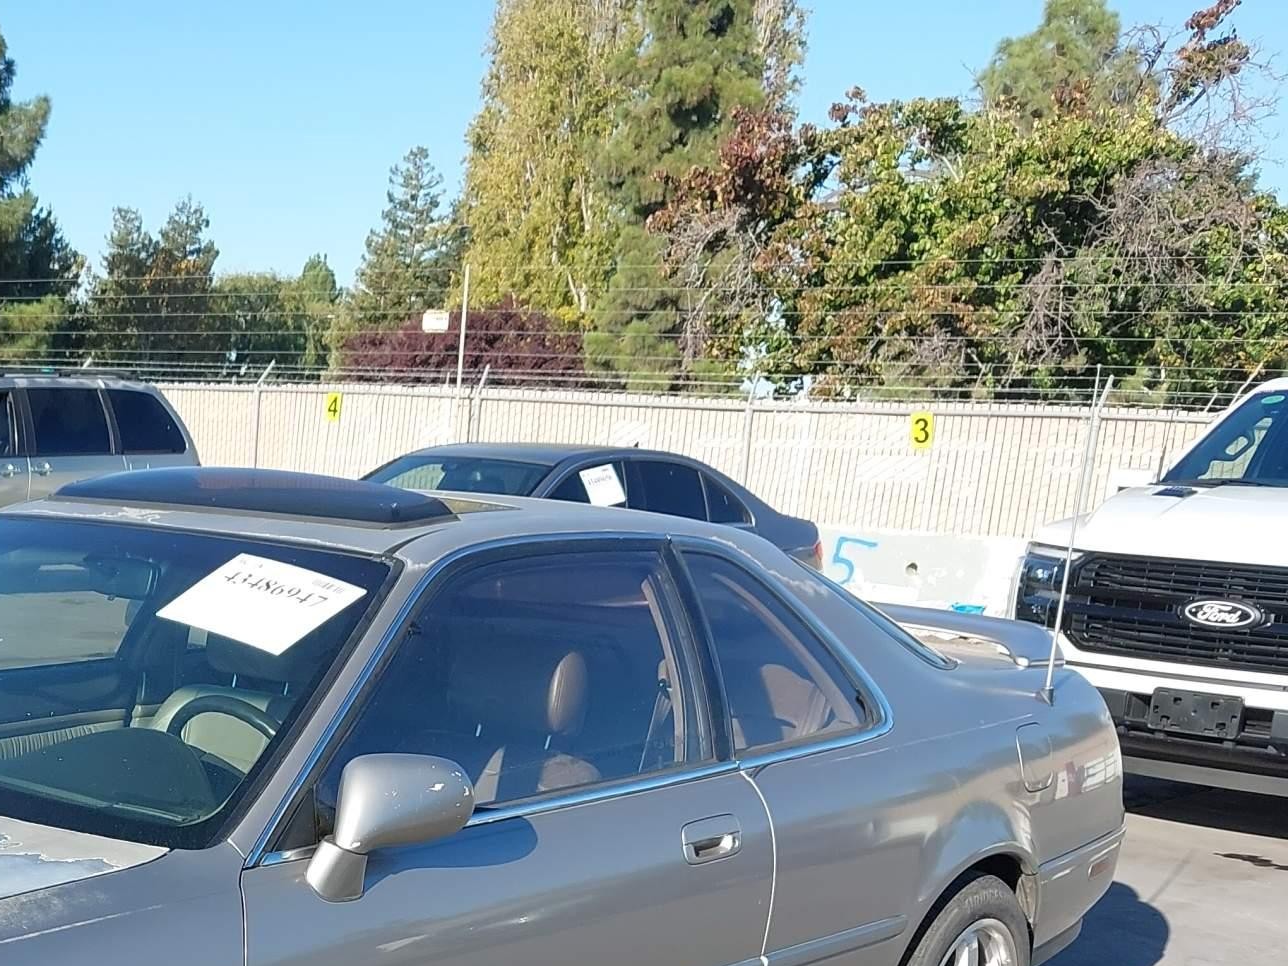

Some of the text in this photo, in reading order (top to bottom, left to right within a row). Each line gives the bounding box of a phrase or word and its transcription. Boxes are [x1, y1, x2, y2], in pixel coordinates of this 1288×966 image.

[328, 396, 338, 417] 4
[914, 418, 929, 443] 3
[832, 536, 878, 585] 5
[224, 571, 328, 607] 43486947
[1197, 603, 1242, 623] Ford
